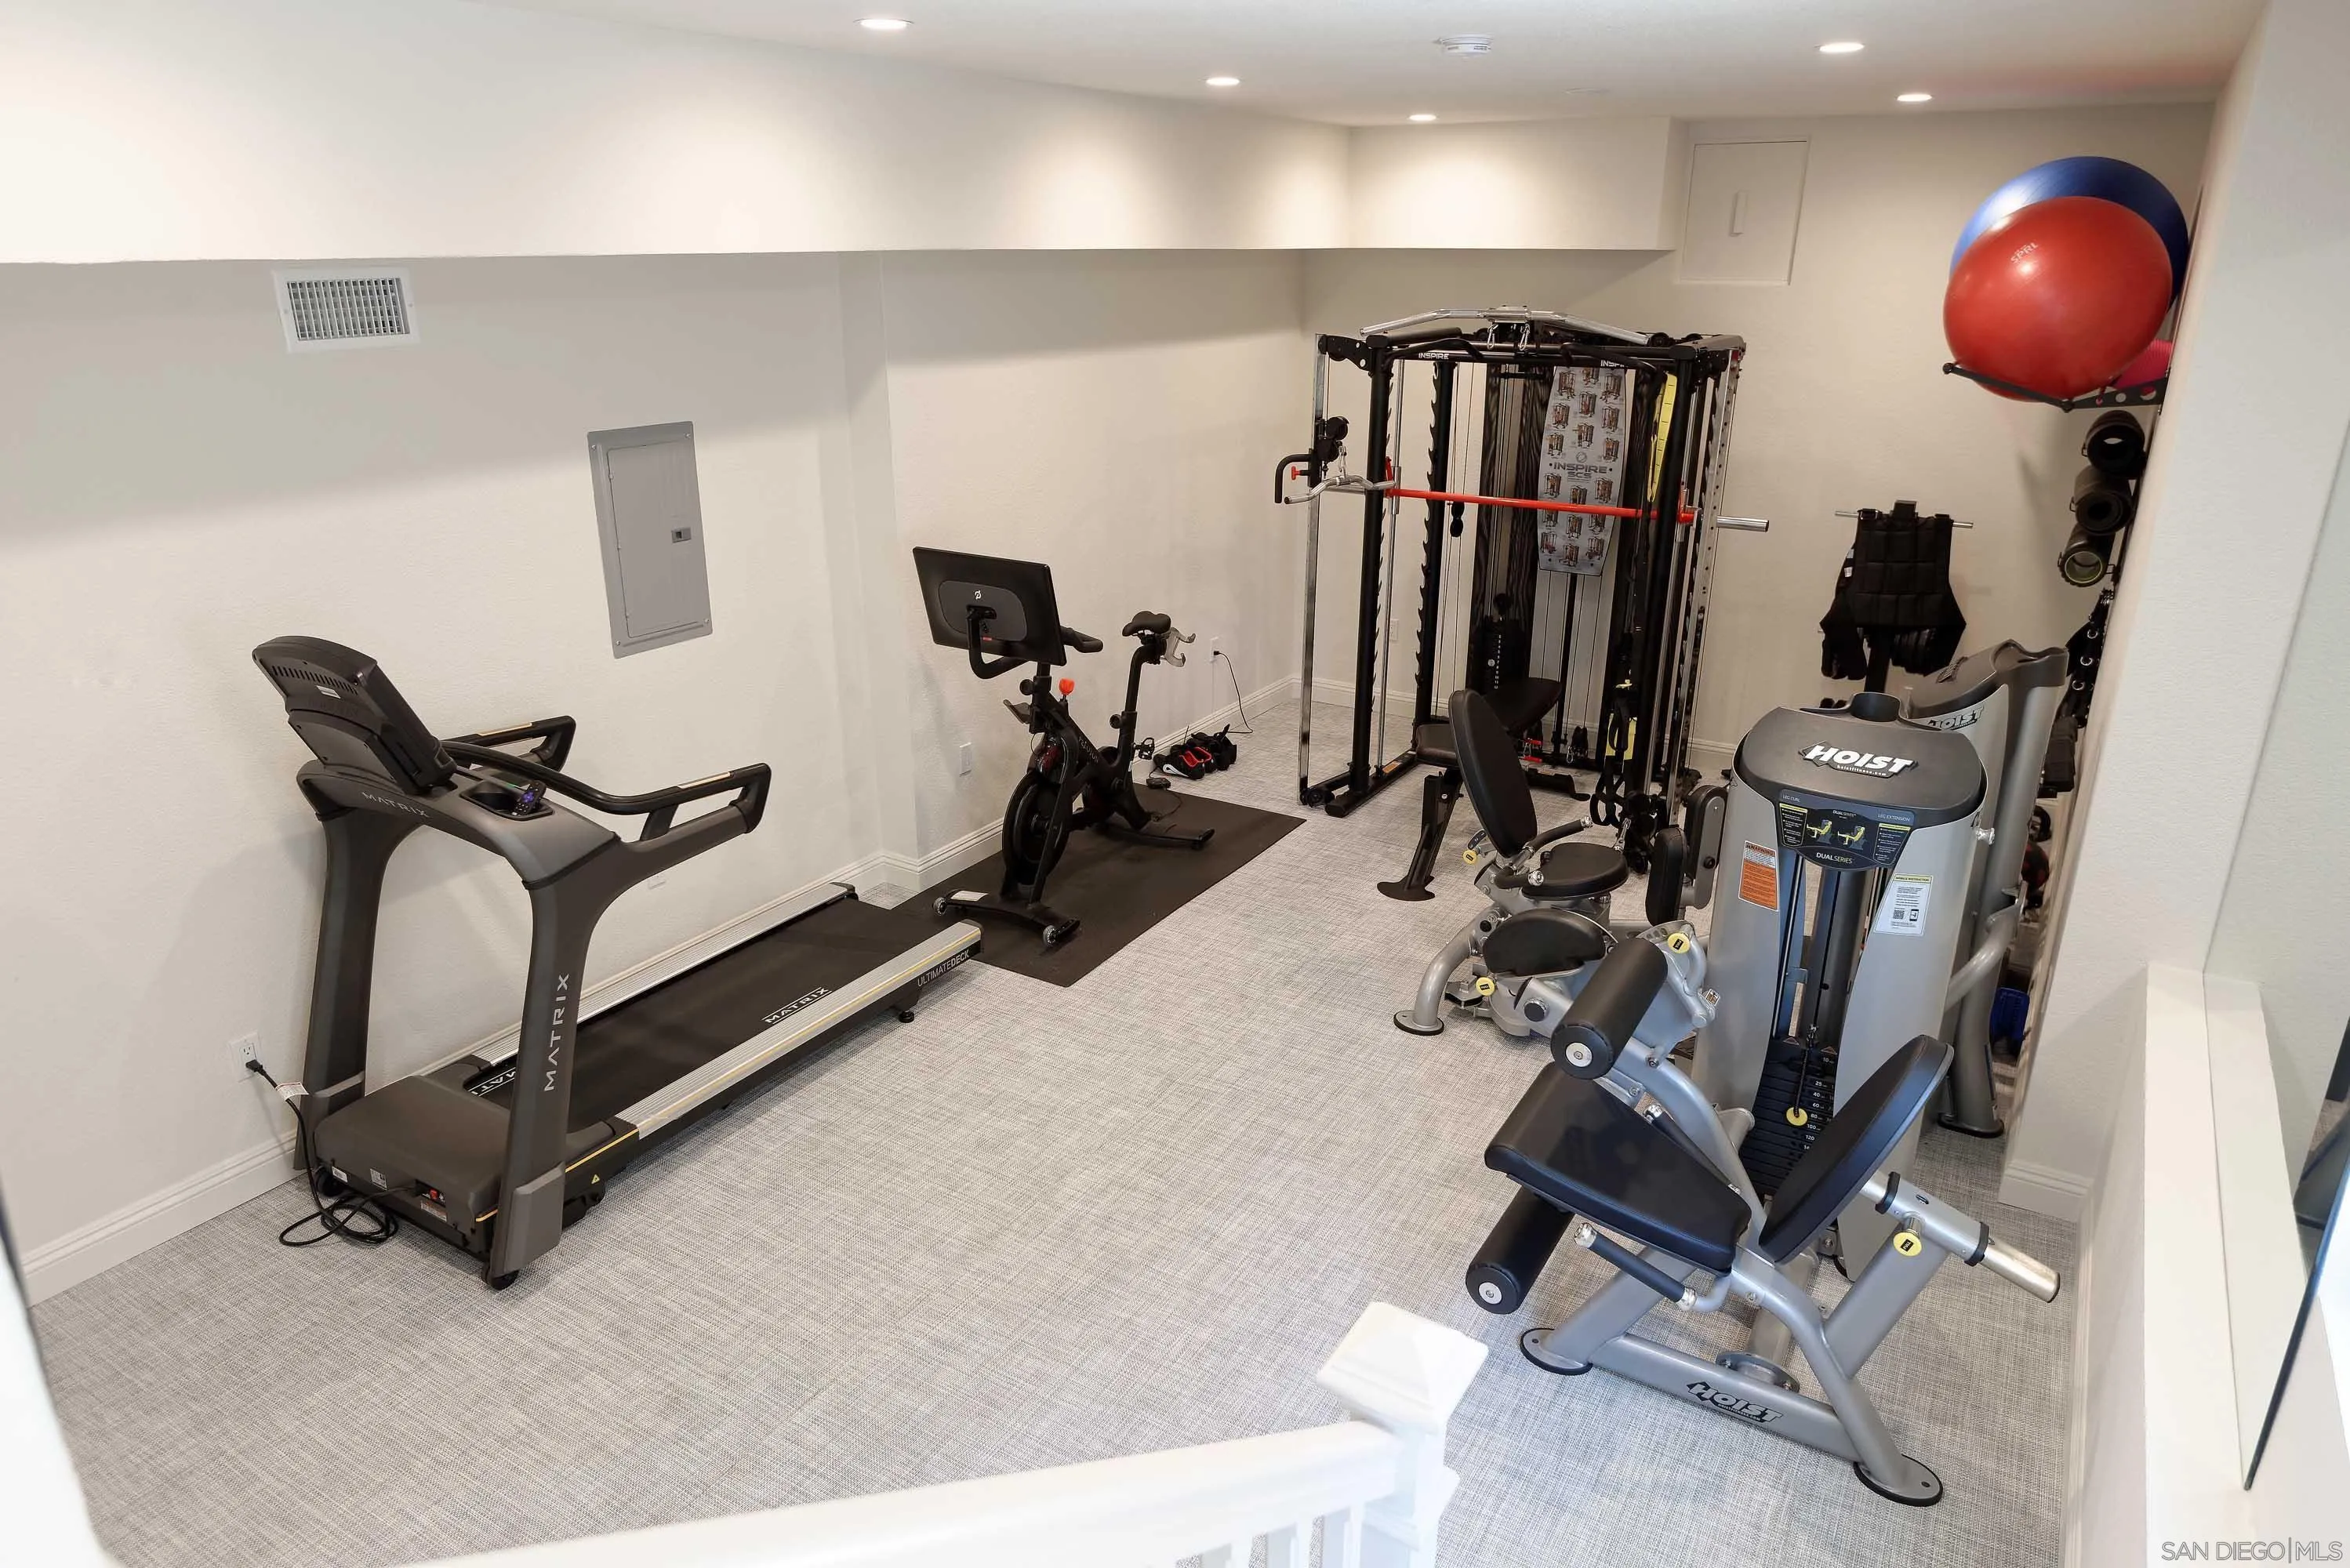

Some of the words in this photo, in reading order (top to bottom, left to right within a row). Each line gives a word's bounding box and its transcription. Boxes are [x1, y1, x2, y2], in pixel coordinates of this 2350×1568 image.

[1553, 462, 1607, 474] INSPIRE
[1805, 745, 1914, 773] HOIST
[362, 791, 430, 818] MATRIX
[1816, 852, 1853, 864] DUALSERIES
[917, 949, 969, 987] ULTIMATEDECK
[765, 988, 829, 1023] MATRIX
[544, 974, 569, 1091] MATRIX
[1688, 1383, 1783, 1422] HOIST
